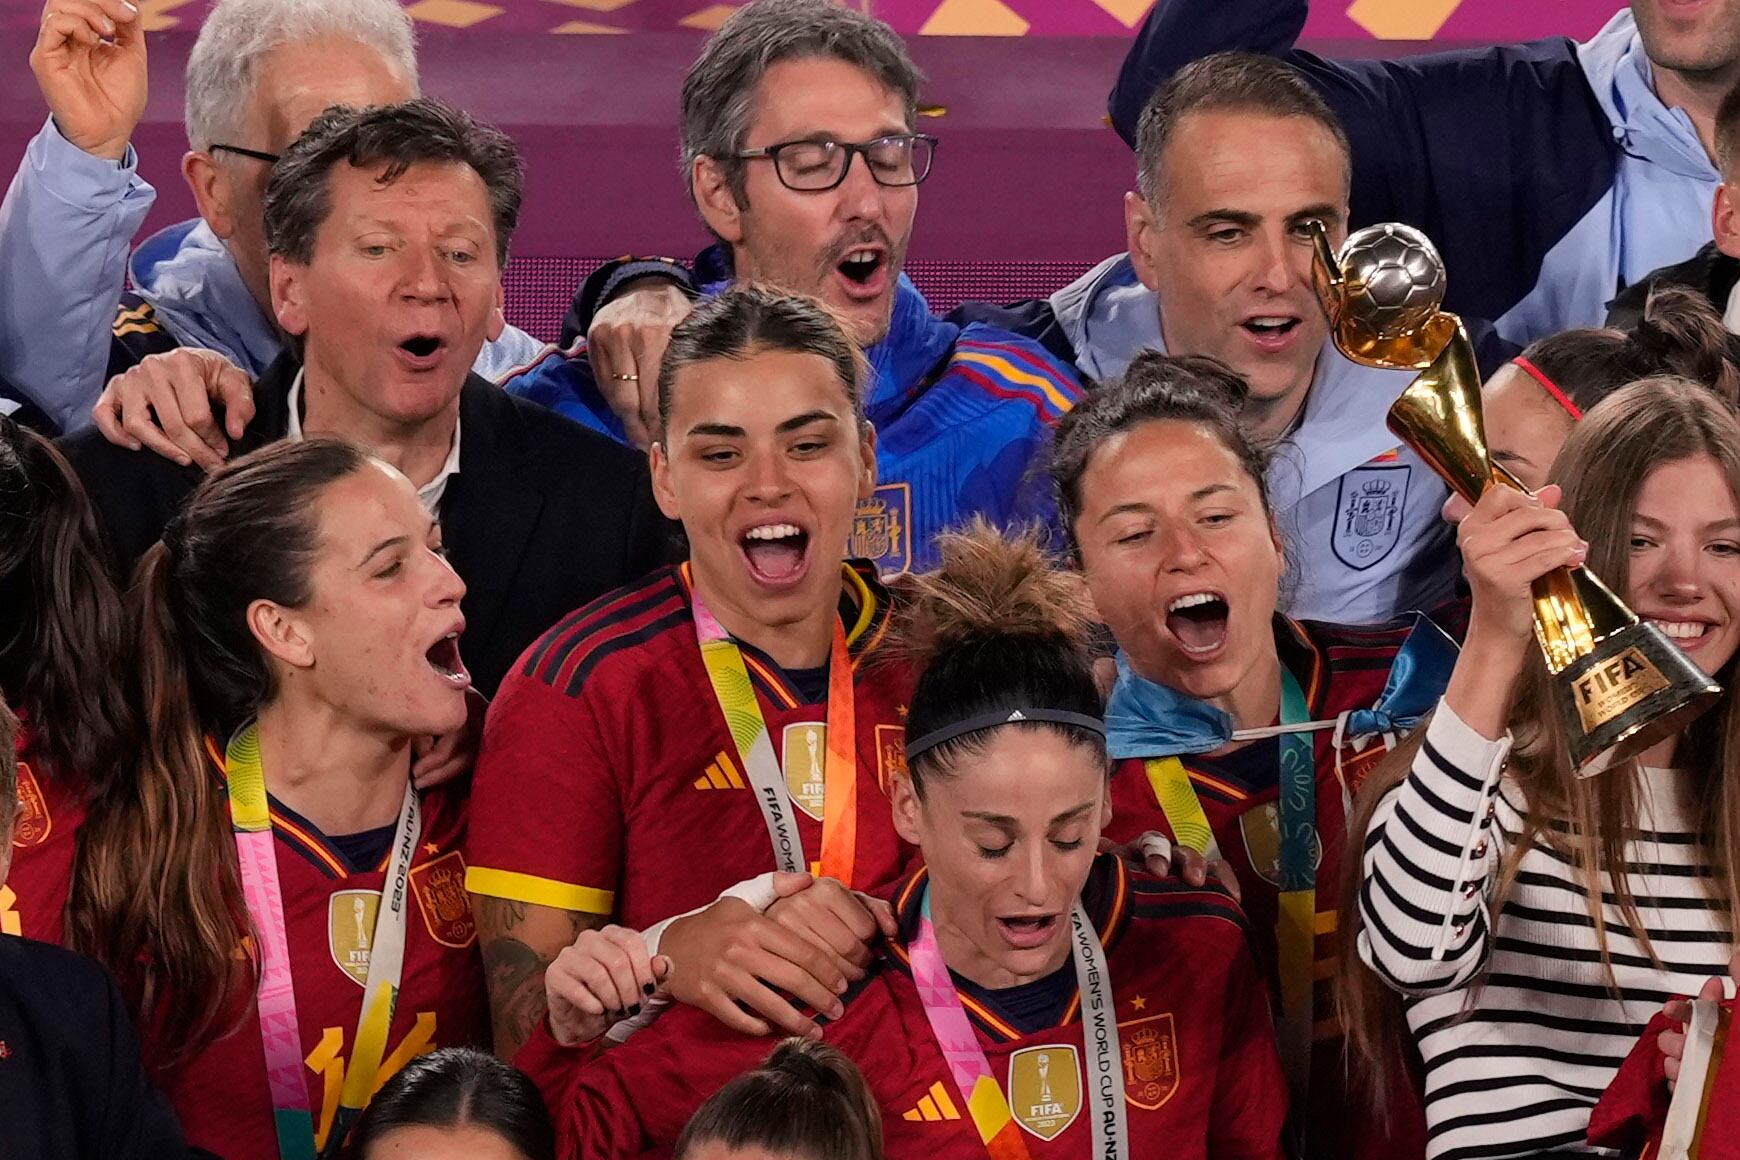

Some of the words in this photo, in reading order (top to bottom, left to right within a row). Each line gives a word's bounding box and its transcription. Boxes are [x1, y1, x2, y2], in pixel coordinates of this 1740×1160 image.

[1578, 656, 1647, 705] FIFA
[763, 787, 783, 822] FIFA
[1077, 931, 1104, 1010] WOMEN'S
[1092, 1012, 1111, 1072] WORLD
[1031, 1103, 1063, 1117] FIFA
[1099, 1074, 1115, 1108] CUP
